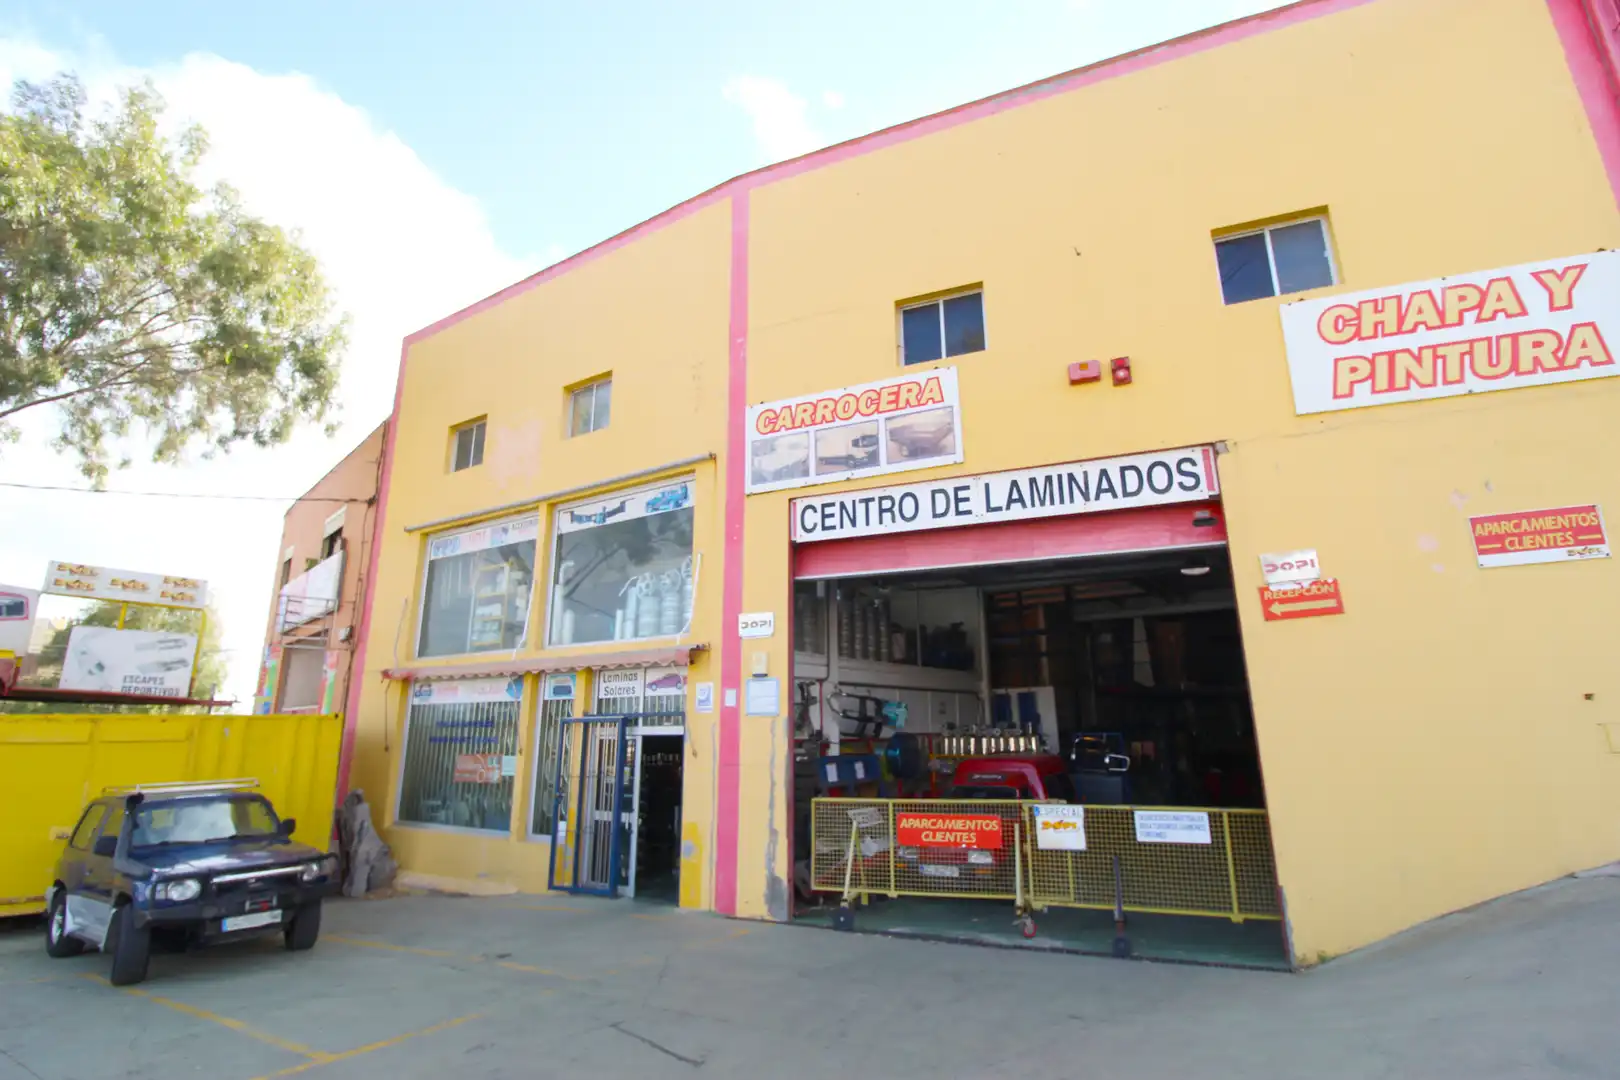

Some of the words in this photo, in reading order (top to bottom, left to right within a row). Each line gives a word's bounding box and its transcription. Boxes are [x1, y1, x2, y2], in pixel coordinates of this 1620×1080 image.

[1317, 276, 1529, 345] CHAPA
[1529, 263, 1589, 313] Y
[1332, 321, 1615, 399] PINTURA
[756, 376, 944, 435] CARROCERA
[800, 491, 920, 534] CENTRO
[930, 485, 973, 519] DE
[984, 457, 1201, 513] LAMINADOS
[1475, 512, 1598, 537] APARCAMIENTOS
[1504, 531, 1575, 550] CLIENTES
[603, 685, 636, 696] Solares
[900, 818, 999, 831] APARCAMIENTOS
[921, 831, 977, 843] CLIENTES
